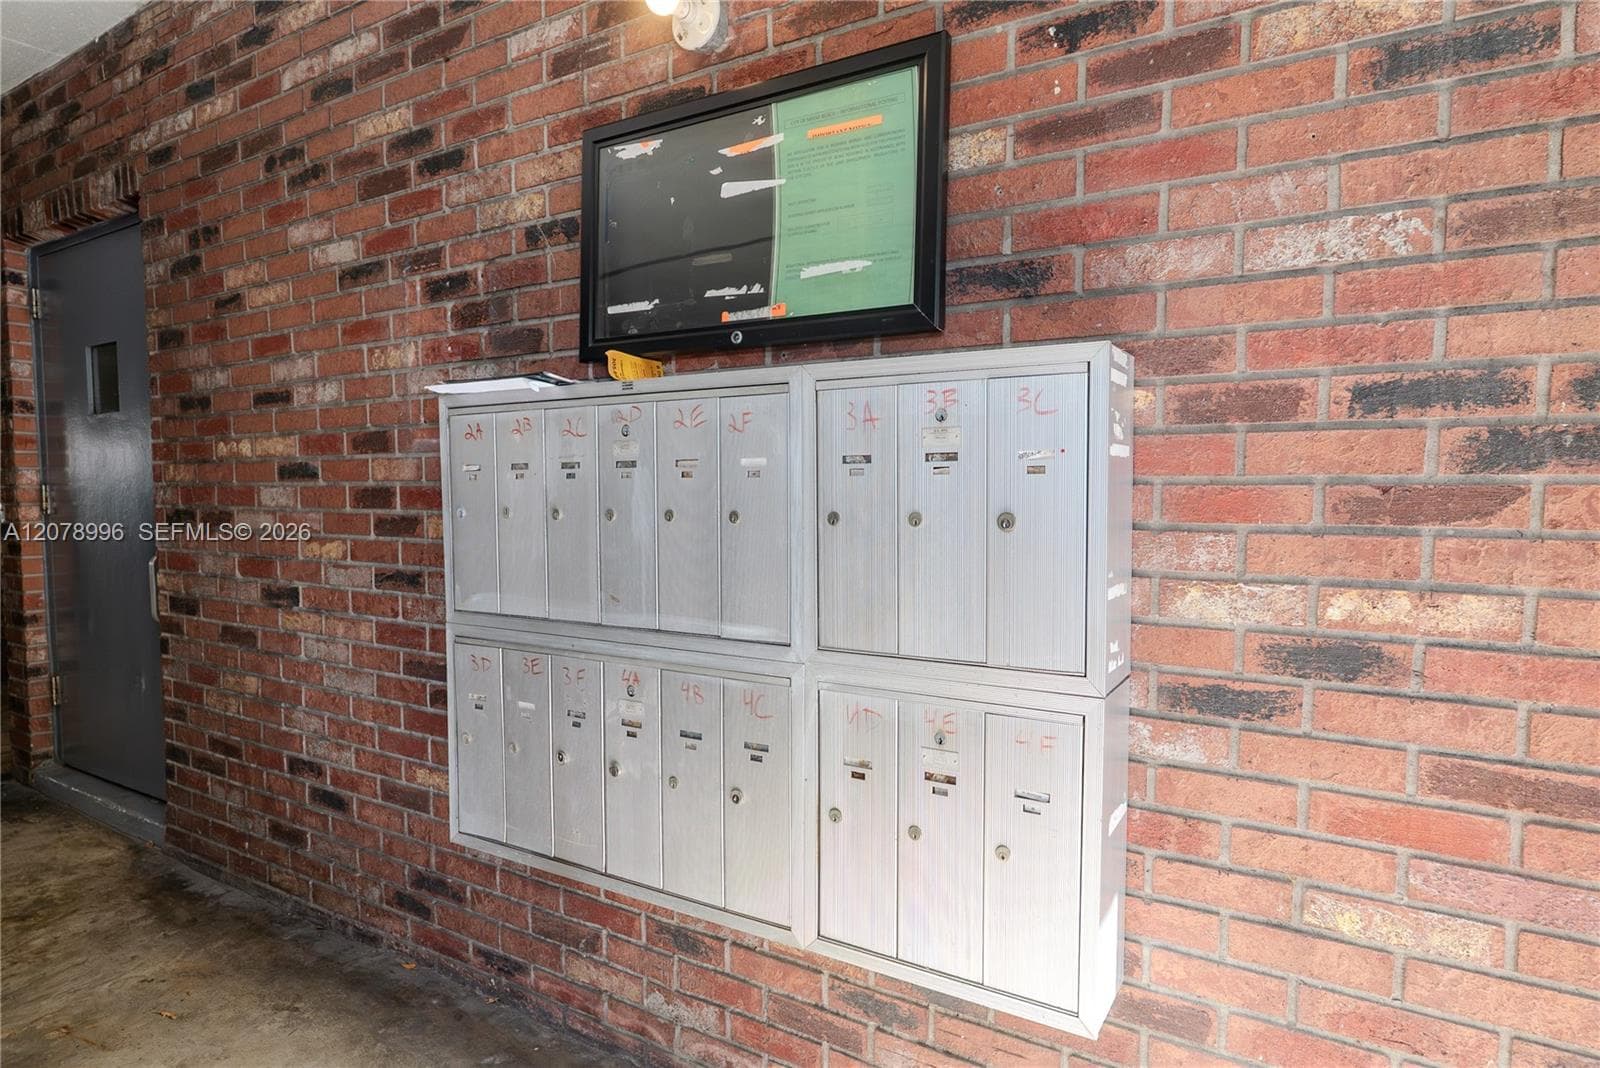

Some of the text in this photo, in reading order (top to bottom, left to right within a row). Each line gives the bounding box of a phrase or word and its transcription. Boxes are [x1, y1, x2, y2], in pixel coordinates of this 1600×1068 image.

[1016, 387, 1059, 416] 3C
[512, 416, 533, 436] 2B
[673, 403, 707, 429] 2E
[728, 411, 753, 433] 2F
[846, 400, 881, 432] 3A
[464, 422, 483, 440] 2A
[470, 654, 492, 672] 3D
[523, 657, 544, 675] 3E
[562, 666, 586, 686] 3F
[621, 668, 640, 685] 4A
[680, 680, 704, 705] 4B
[743, 688, 774, 719] 4C
